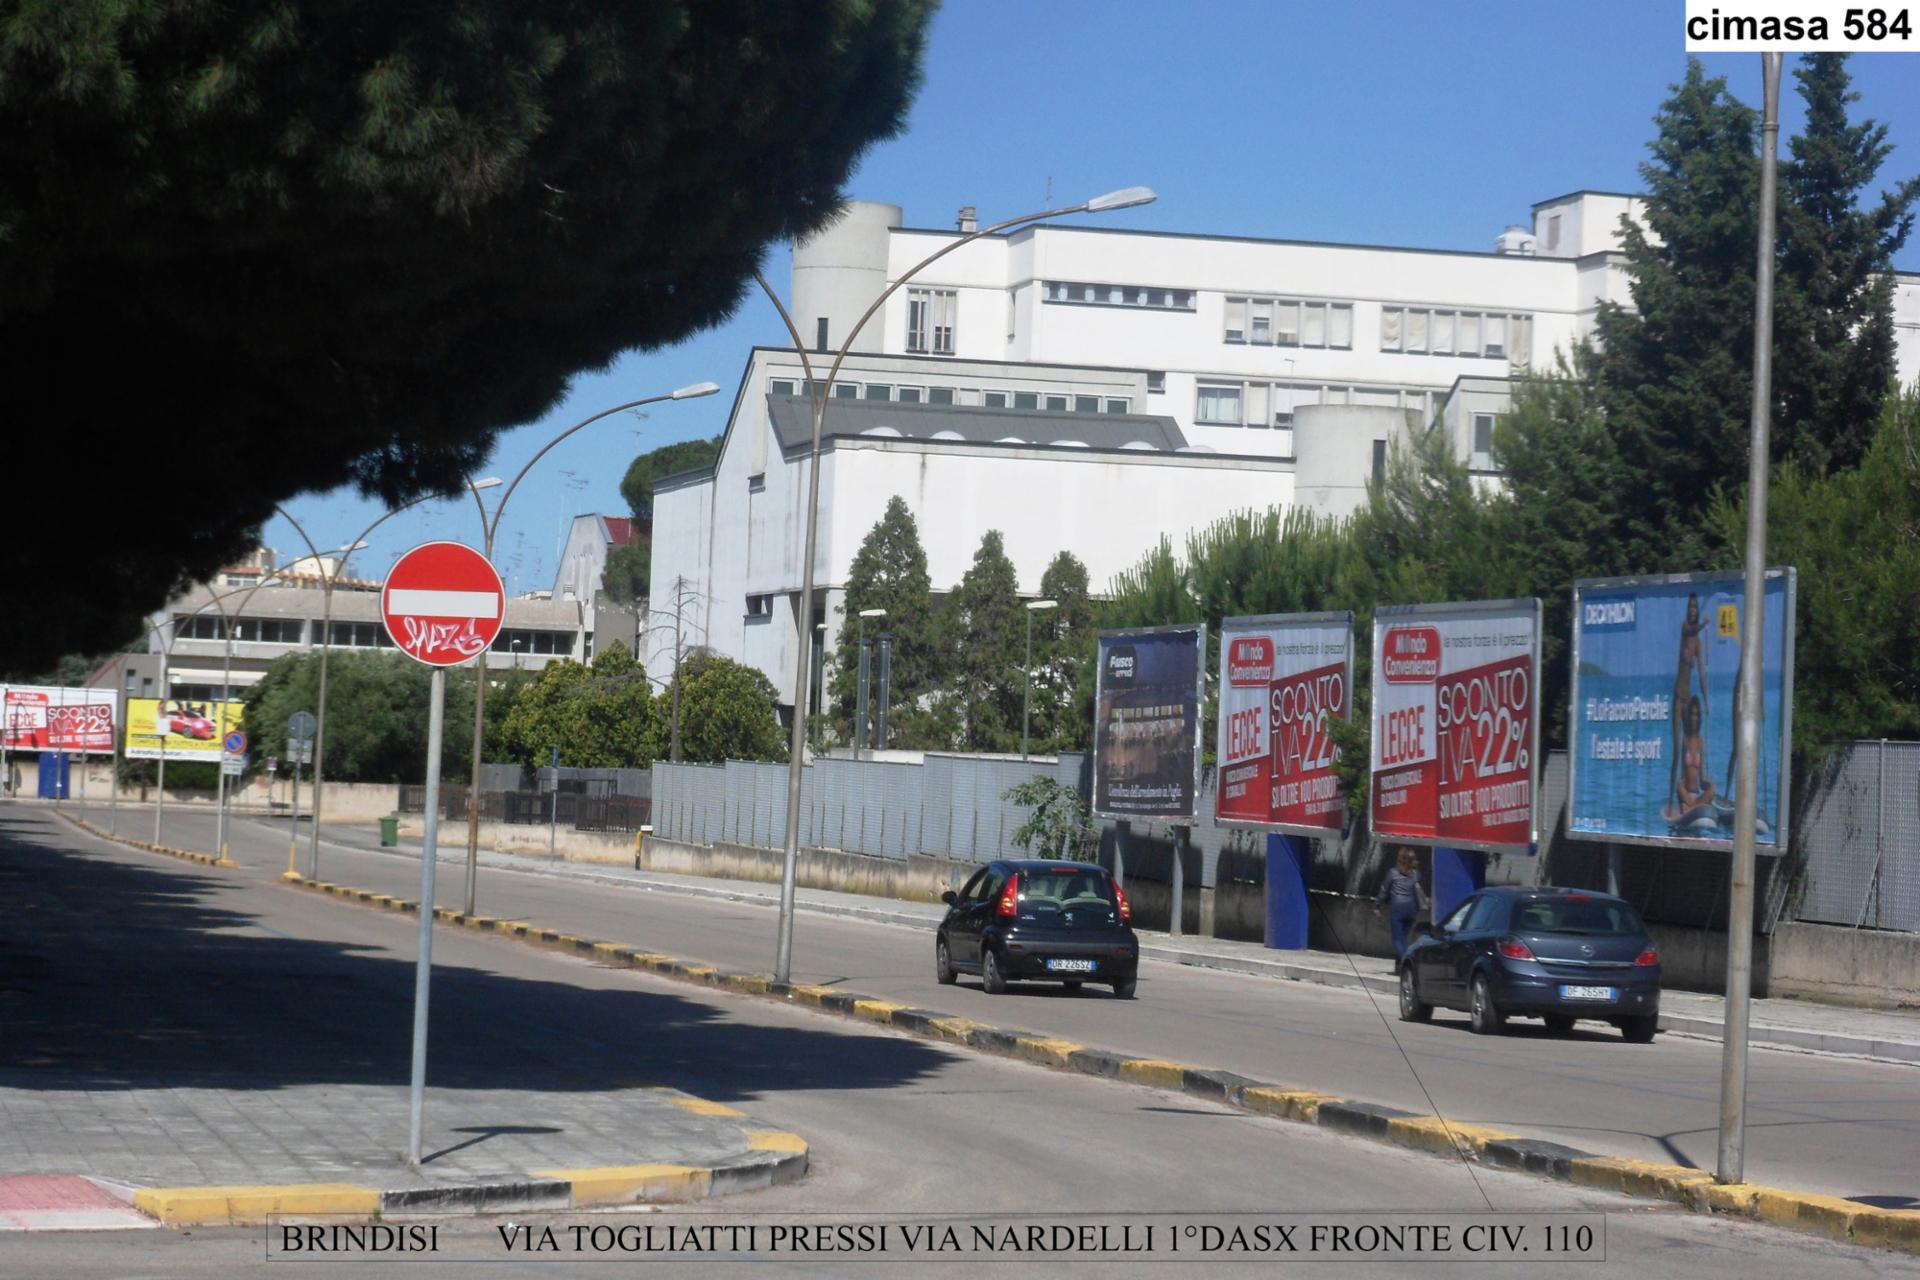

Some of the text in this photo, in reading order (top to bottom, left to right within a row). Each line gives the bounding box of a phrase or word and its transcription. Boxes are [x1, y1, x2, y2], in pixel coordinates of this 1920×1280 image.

[1585, 602, 1635, 625] DECATHLON
[1385, 655, 1438, 676] Convenienza
[47, 706, 110, 721] SCONTO
[1271, 672, 1343, 727] SCONTO
[1438, 667, 1529, 728] SCONTO
[48, 718, 77, 735] IVA
[75, 716, 112, 734] 22%
[1226, 706, 1262, 761] LECCE
[1381, 704, 1425, 766] LECCE
[1438, 706, 1529, 785] IVA 22%
[1271, 724, 1303, 778] IVA
[1634, 736, 1662, 766] sport
[1439, 793, 1450, 819] SU
[1451, 789, 1474, 818] OLTRE
[1475, 786, 1490, 813] 100
[1490, 779, 1530, 811] PRODOTTI
